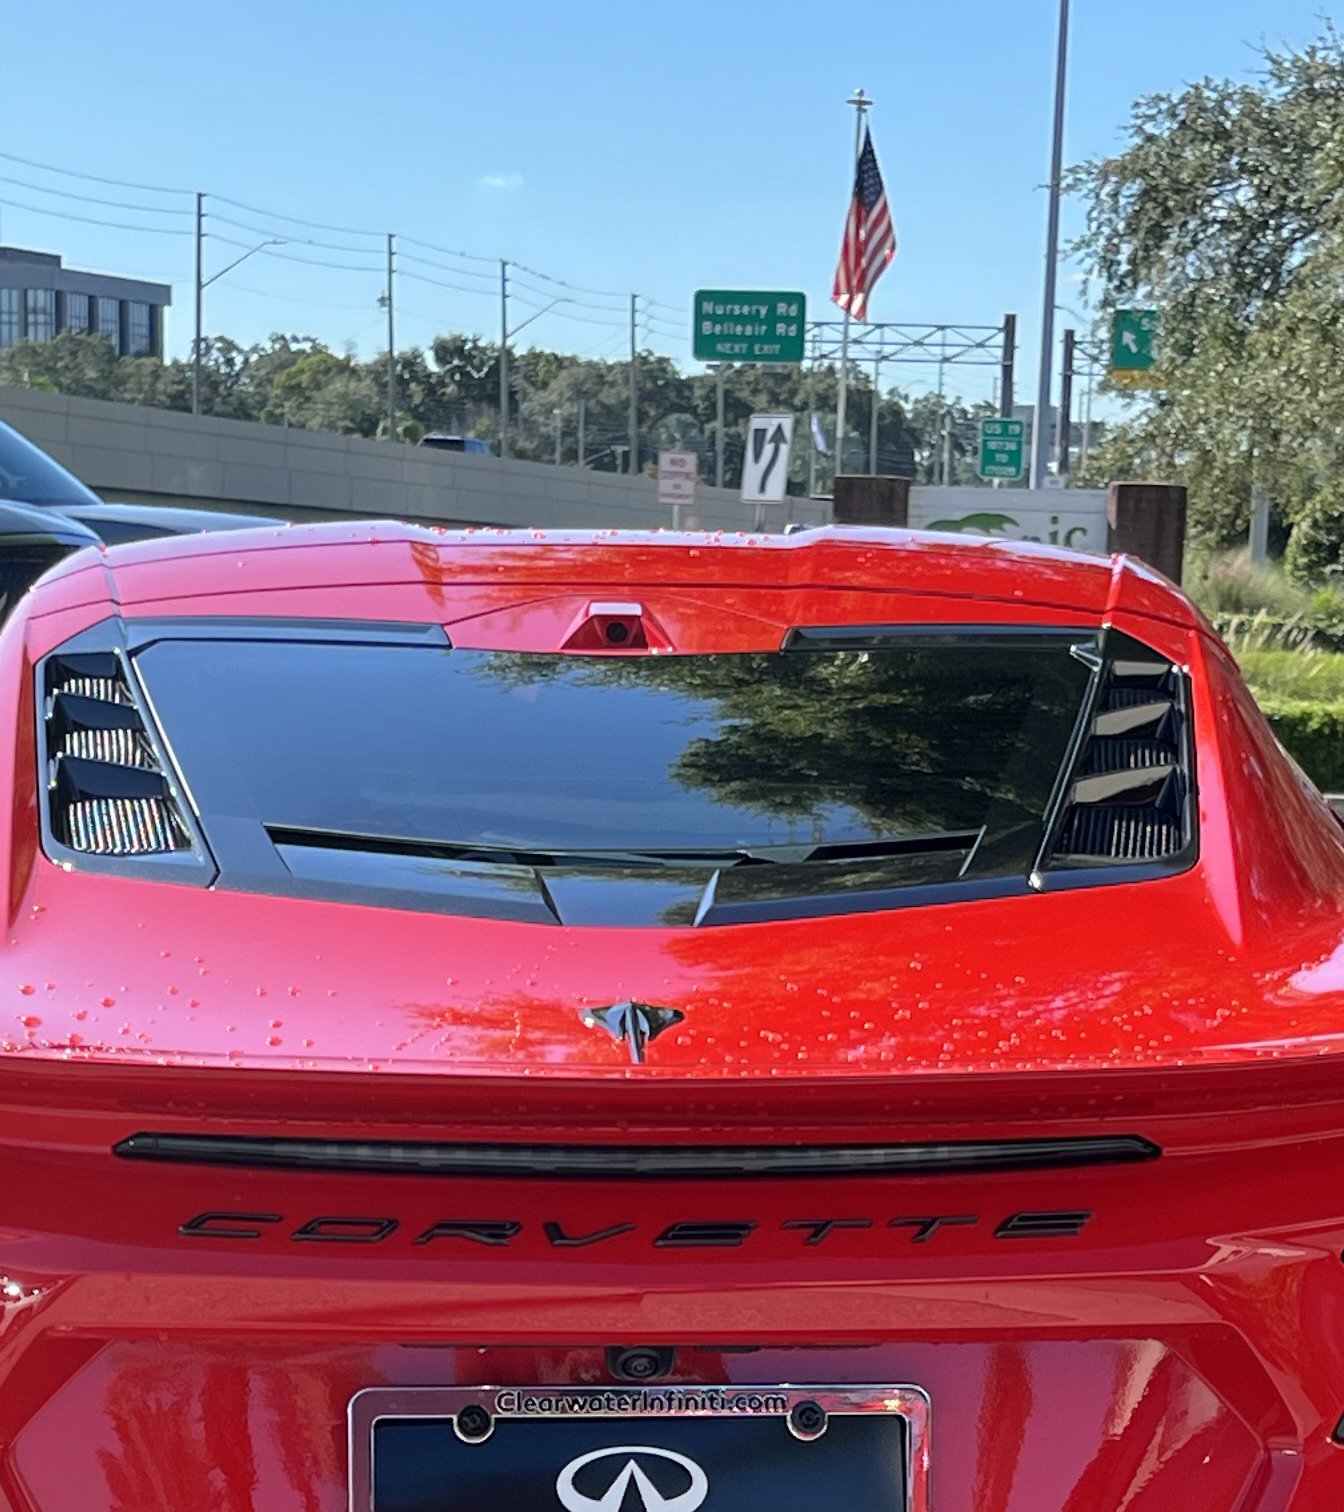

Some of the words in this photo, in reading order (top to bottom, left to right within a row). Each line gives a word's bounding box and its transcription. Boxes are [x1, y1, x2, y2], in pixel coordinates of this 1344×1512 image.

[701, 302, 769, 320] Nursery
[776, 302, 798, 317] Rd
[701, 321, 768, 336] Belleair
[775, 322, 798, 337] Rd
[715, 343, 748, 354] NEXT
[753, 344, 781, 355] EXIT
[984, 423, 1003, 435] US
[175, 1209, 1095, 1248] CORVETTE
[495, 1390, 788, 1414] ClearwaterInfiniti.com
